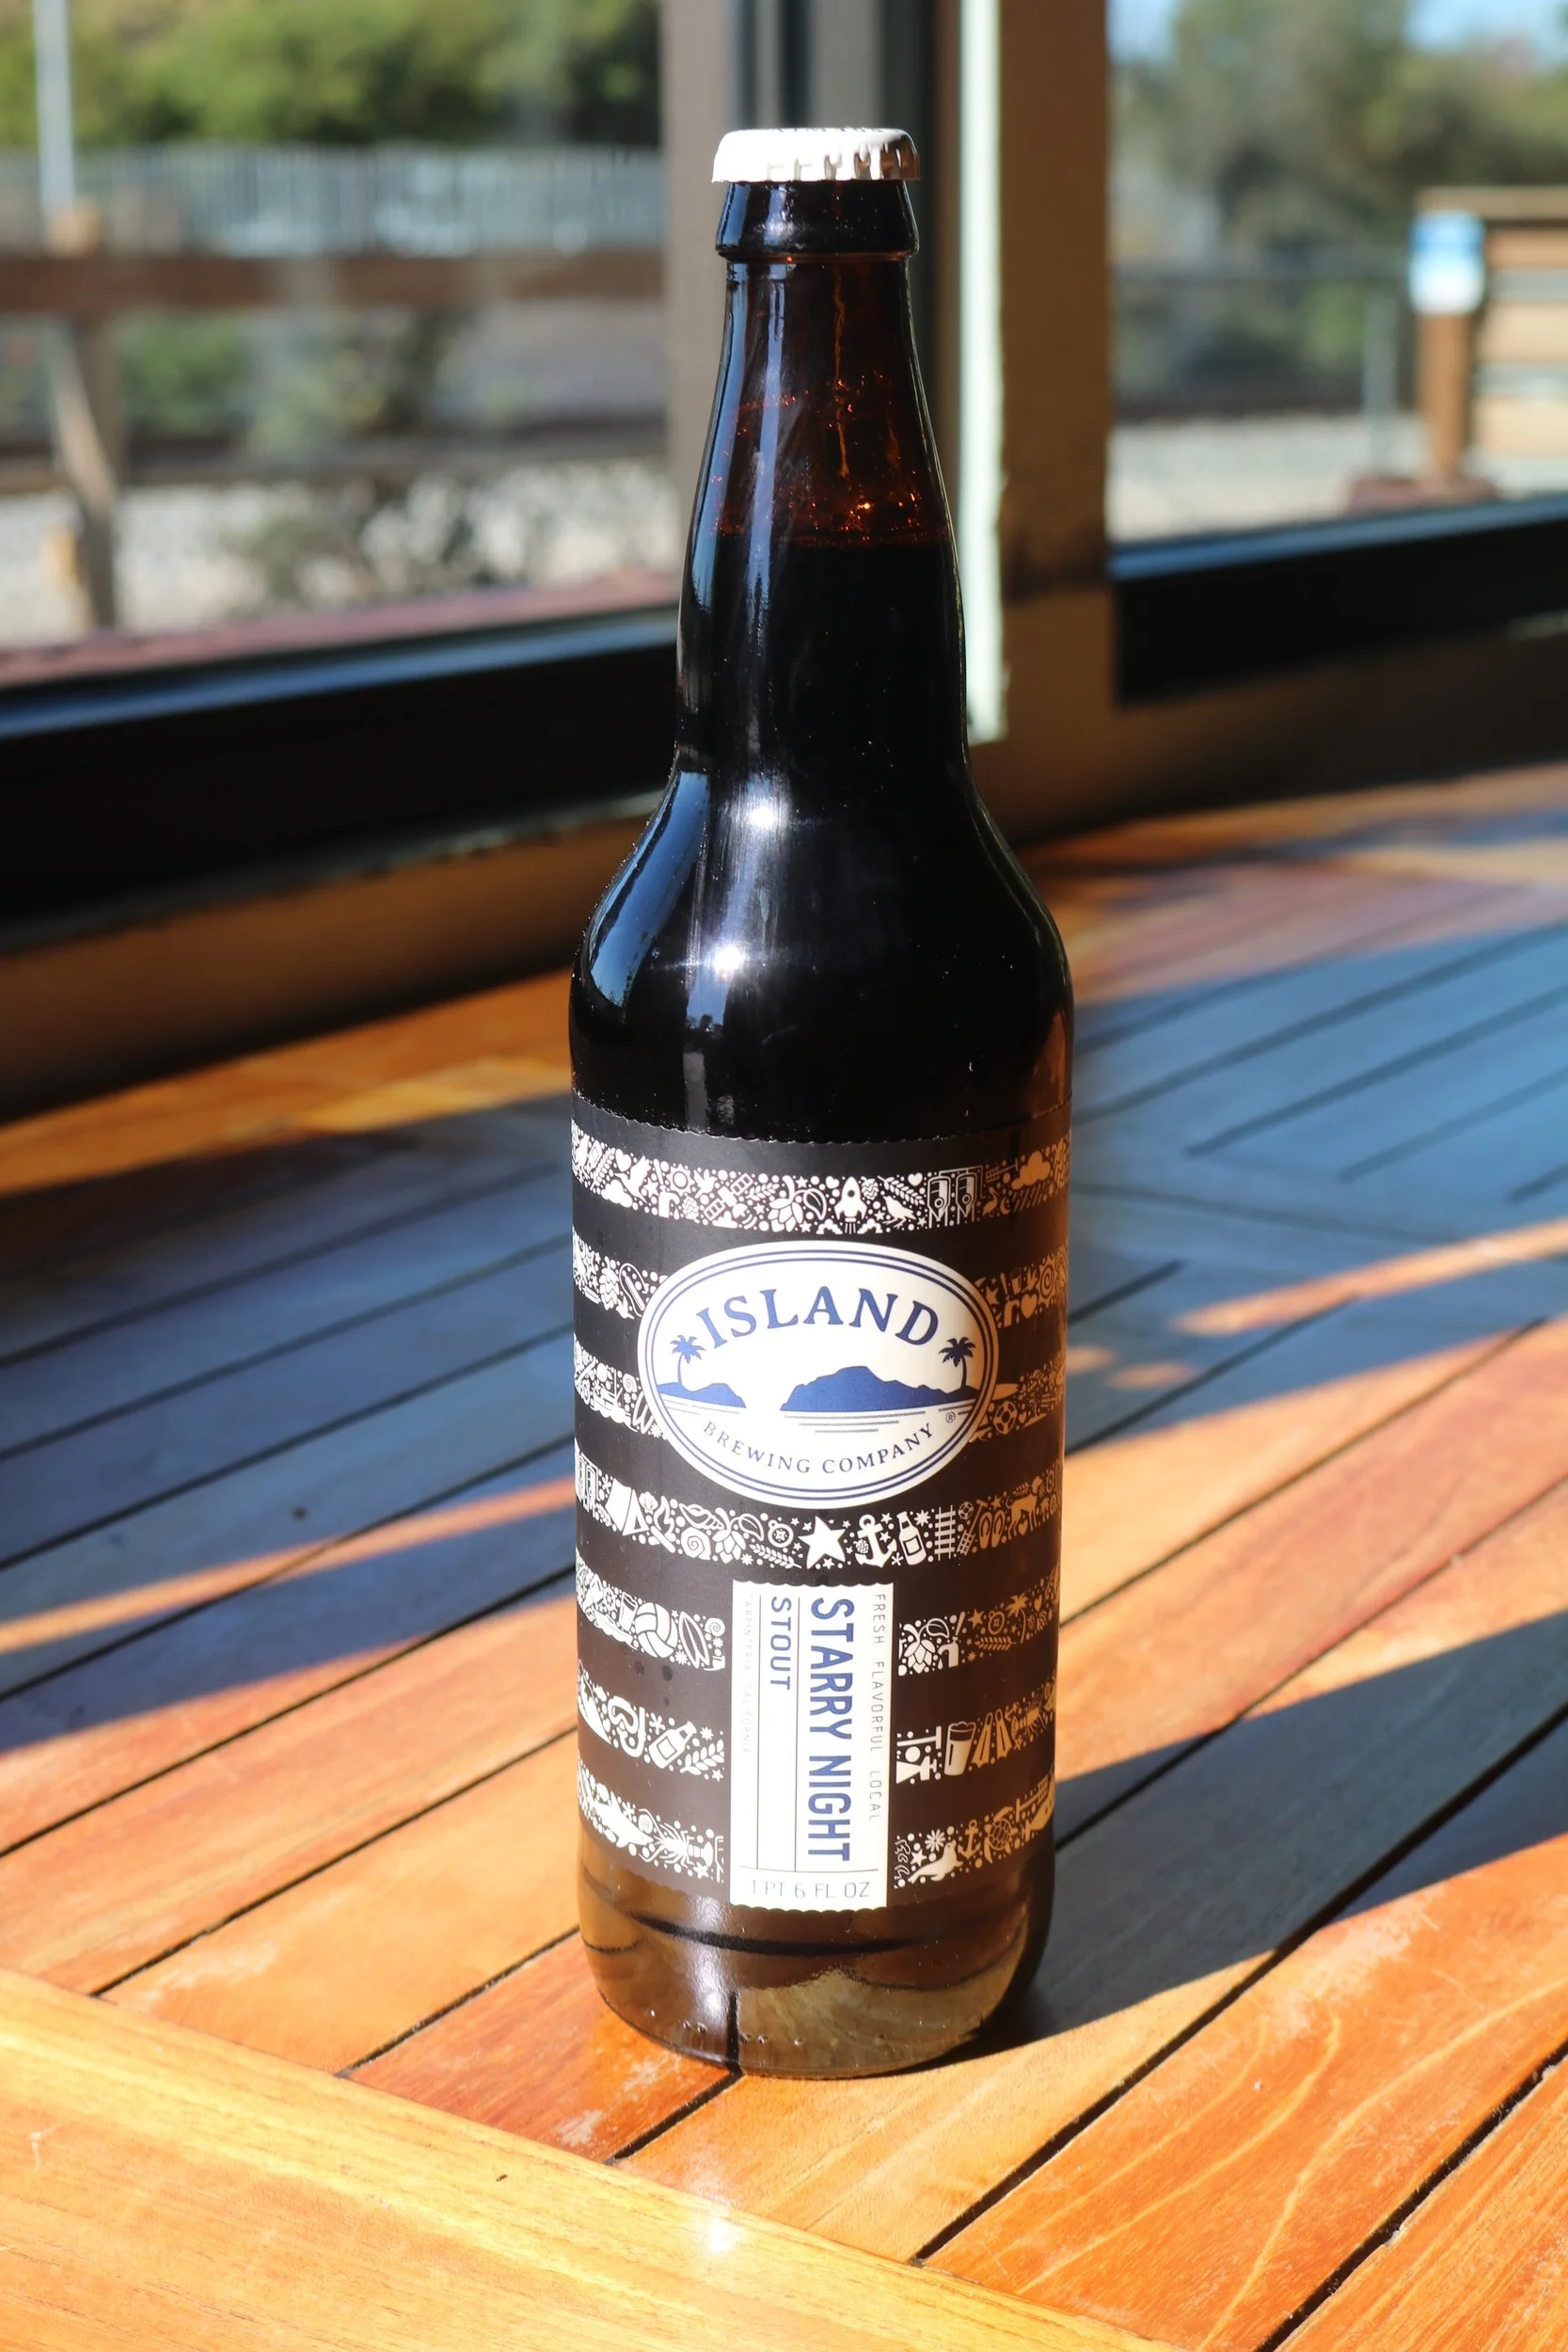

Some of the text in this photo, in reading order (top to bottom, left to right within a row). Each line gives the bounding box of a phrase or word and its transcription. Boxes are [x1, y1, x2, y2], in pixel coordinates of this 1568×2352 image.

[696, 1285, 939, 1349] ISLAND
[703, 1421, 933, 1474] BREWING COMPANY
[769, 1596, 792, 1691] STOUT
[807, 1597, 855, 1861] STARRY NIGHT
[868, 1594, 886, 1821] FRESH FLAVORFUL LOCAL
[752, 1880, 871, 1899] 1 PT 6 FL OZ
